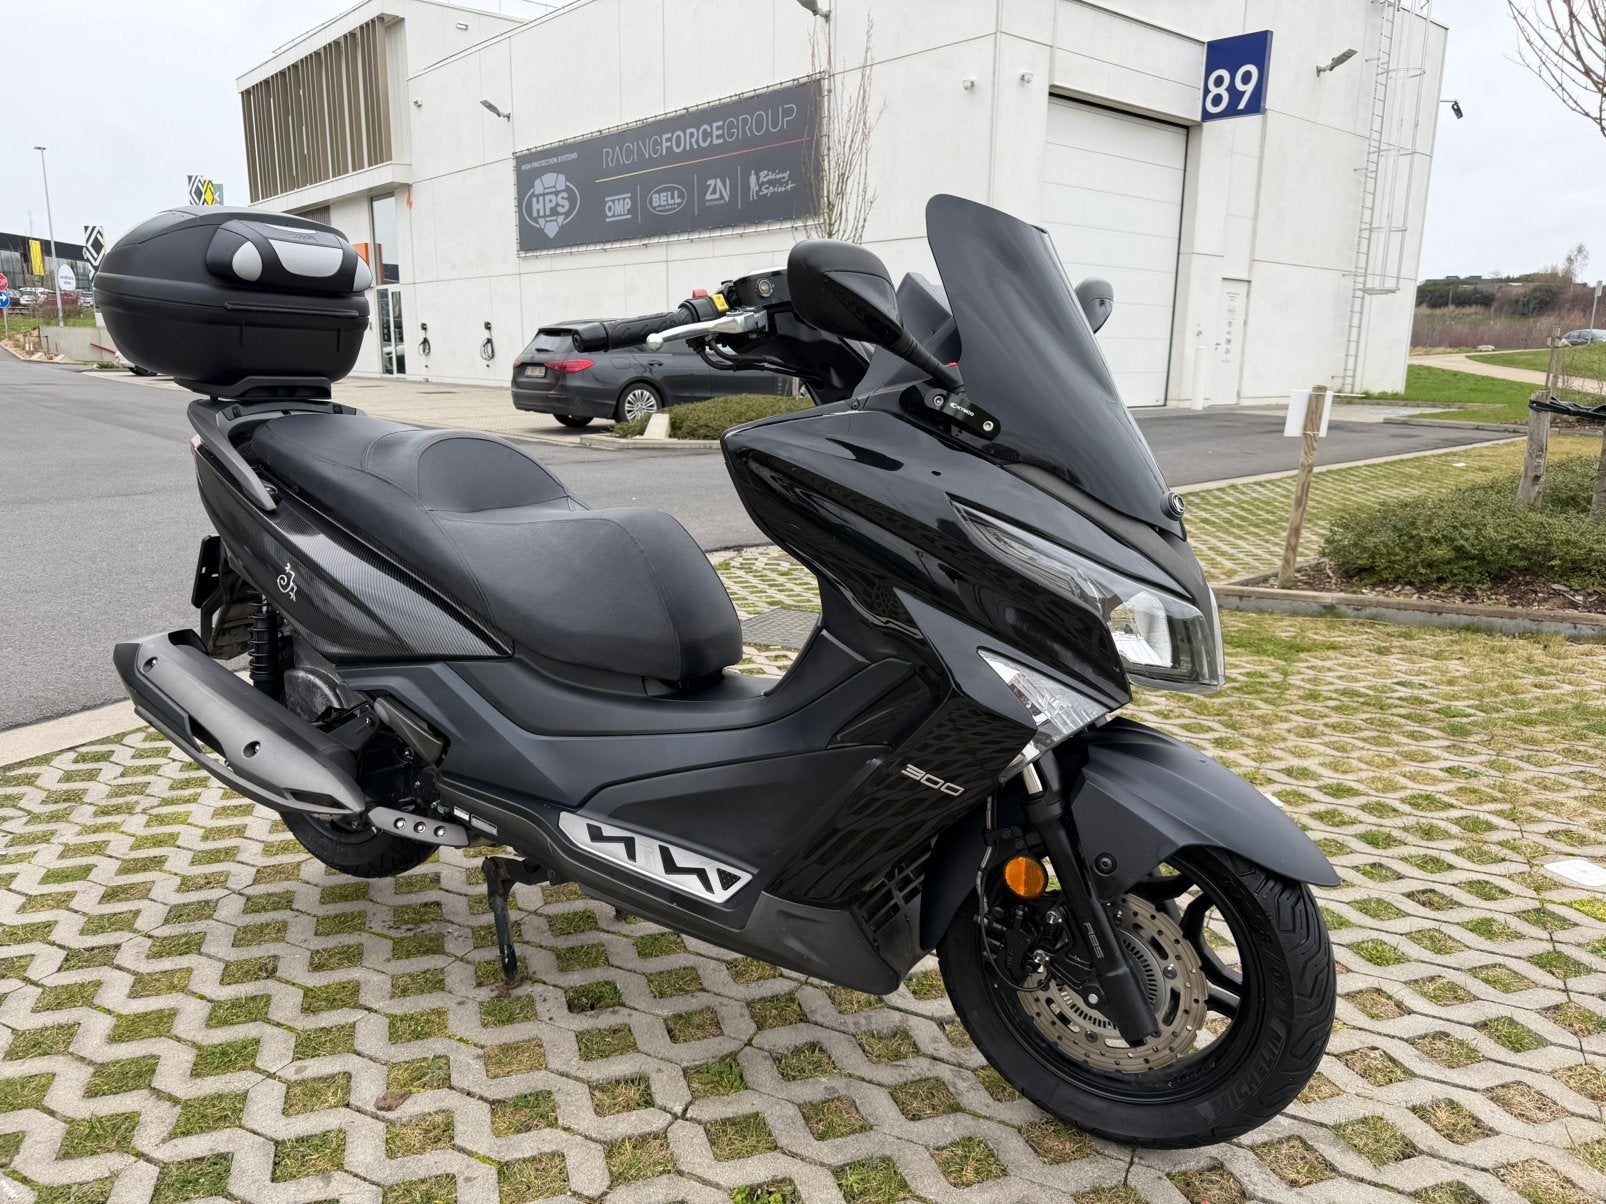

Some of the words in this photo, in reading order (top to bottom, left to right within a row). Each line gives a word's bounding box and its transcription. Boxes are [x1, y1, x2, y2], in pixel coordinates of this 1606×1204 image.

[1204, 63, 1259, 114] 89
[652, 190, 682, 207] BELL
[759, 180, 796, 197] Spirit
[532, 192, 570, 218] HPS
[605, 198, 632, 217] OMP
[901, 763, 965, 797] 300
[1083, 922, 1104, 959] ABS
